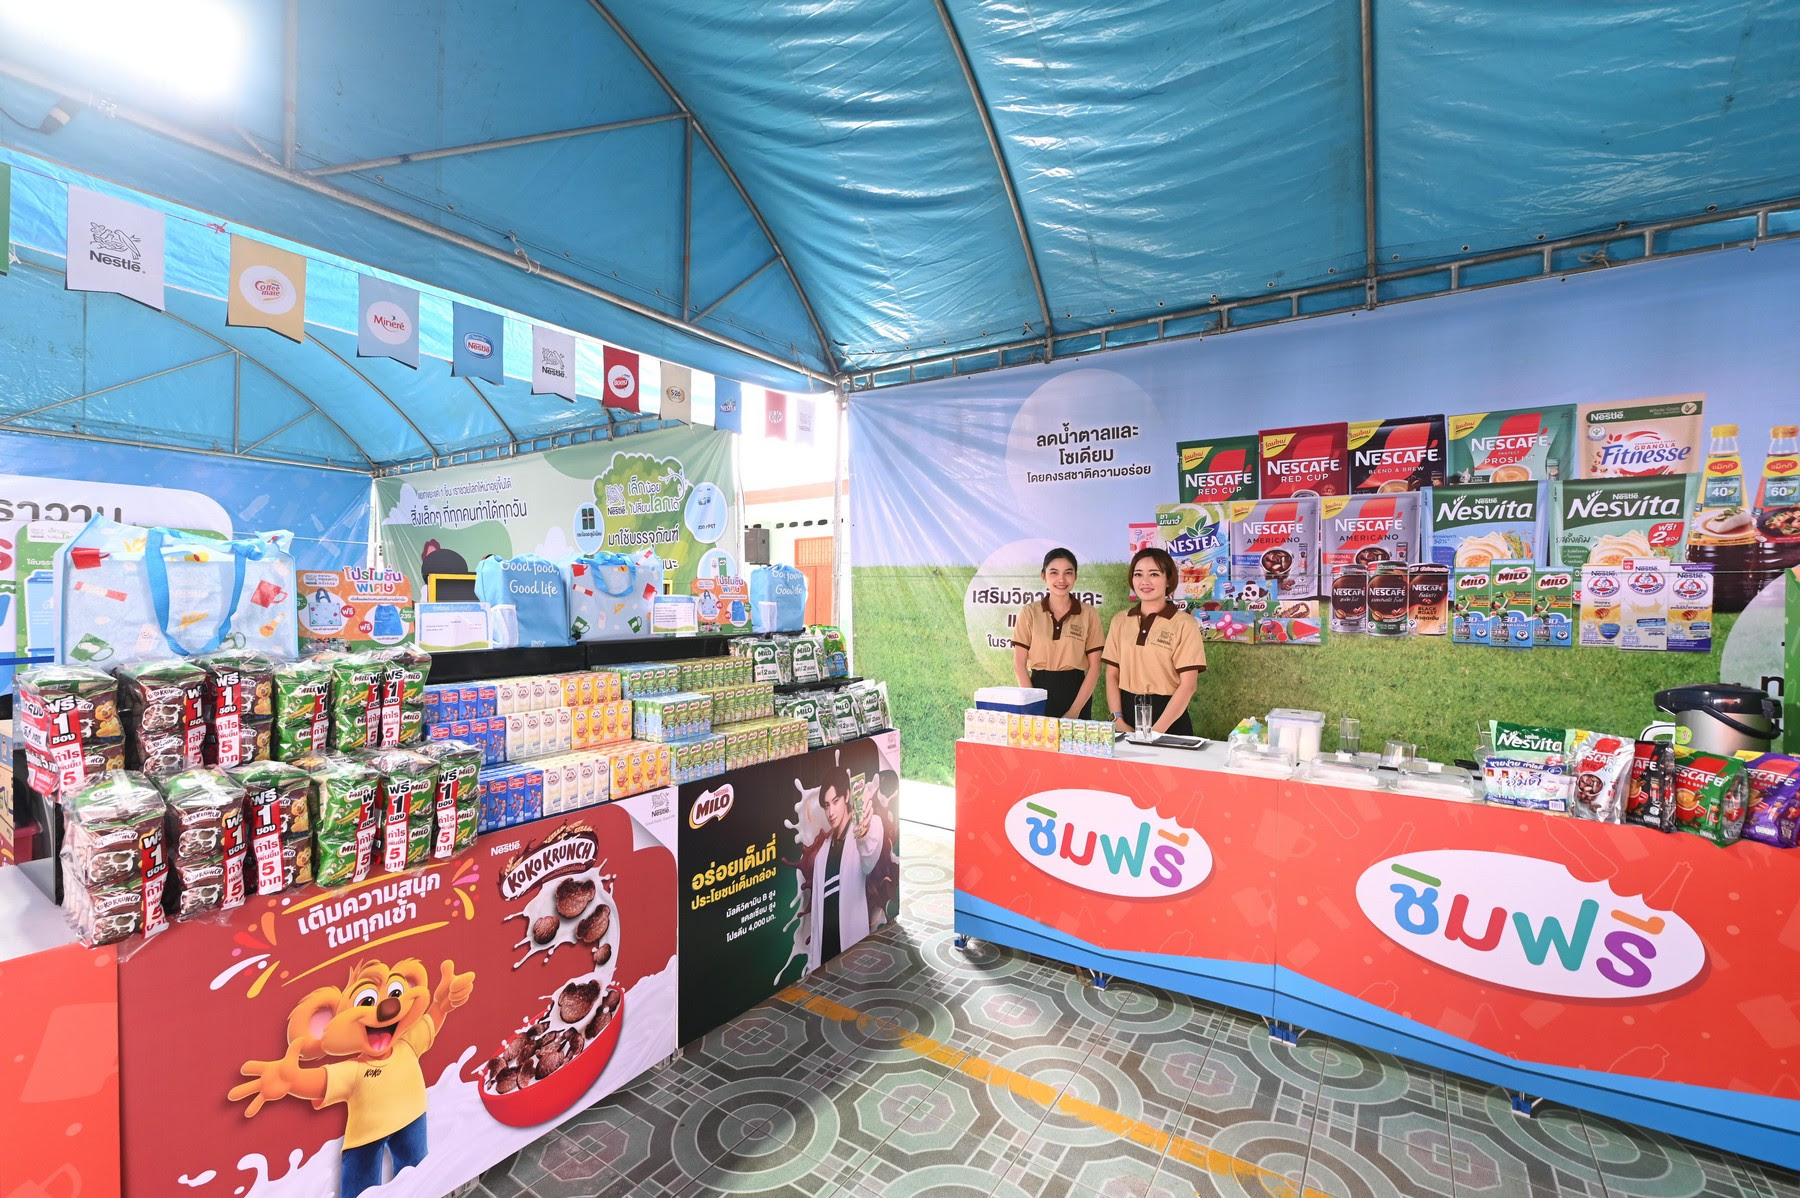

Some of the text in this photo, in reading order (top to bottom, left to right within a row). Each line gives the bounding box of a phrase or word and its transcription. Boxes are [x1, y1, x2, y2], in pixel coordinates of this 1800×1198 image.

[89, 250, 141, 272] Nestlé
[1590, 411, 1624, 421] Nestlé
[1036, 422, 1139, 448] ลดน้ำตาลและ
[1471, 428, 1549, 452] NESCAFÉ
[1355, 440, 1438, 467] NESCAFÉ
[1634, 442, 1676, 451] GRANOLA
[1058, 445, 1114, 465] โซเดียม
[1267, 450, 1340, 475] NESCAFÉ
[1484, 455, 1533, 465] PROSLIM
[1601, 444, 1692, 466] Fitnesse
[1027, 463, 1152, 483] โดยคงรสชาติความอร่อย
[1185, 465, 1253, 488] NESCAFÉ
[1281, 474, 1329, 483] RED CUP
[1198, 486, 1242, 495] RED CUP
[443, 498, 528, 528] ที่ทุกคนทำได้ทุกวัน
[1436, 497, 1533, 523] Nesvita
[1566, 494, 1680, 520] Nesvita
[1242, 516, 1304, 535] NESCAFÉ
[1335, 512, 1403, 532] NESCAFÉ
[1166, 536, 1220, 554] NESTEA
[1338, 534, 1399, 542] AMERICANO
[1650, 531, 1668, 544] 2
[1460, 579, 1487, 587] MILO
[1497, 572, 1529, 582] MILO
[1540, 578, 1568, 587] MILO
[509, 579, 558, 597] Good life
[1369, 587, 1406, 597] NESCAFÉ
[796, 646, 811, 654] MILO
[216, 672, 240, 688] ฟรี
[385, 669, 405, 681] ฟรี
[222, 686, 234, 706] 1
[389, 682, 399, 698] 1
[46, 695, 77, 713] ฟรี
[796, 706, 813, 715] MILO
[52, 712, 71, 735] 1
[385, 727, 394, 739] 5
[221, 741, 234, 753] 5
[1497, 732, 1563, 752] Nesvita
[63, 771, 77, 786] 5
[438, 769, 458, 783] ฟรี
[458, 767, 475, 776] MILO
[1676, 767, 1724, 787] ESCAFÉ
[389, 781, 410, 794] ฟรี
[410, 783, 429, 791] MILO
[441, 783, 451, 800] 1
[1692, 782, 1709, 790] BREW
[250, 788, 278, 806] ฟรี
[393, 795, 404, 813] 1
[257, 804, 272, 825] 1
[695, 793, 730, 820] MILO
[457, 811, 474, 820] MILO
[232, 826, 244, 845] 1
[388, 829, 406, 838] กำไร
[410, 829, 429, 838] MILO
[440, 831, 450, 843] 5
[255, 840, 279, 853] กำไร
[490, 841, 521, 857] Nestlé
[1025, 801, 1190, 888] ชิมฟรี
[150, 847, 163, 867] 1
[389, 848, 401, 860] 5
[691, 833, 777, 891] อร่อยเต็มที่
[261, 862, 275, 877] 5
[507, 858, 542, 894] KOKO
[542, 841, 593, 871] KRUNCH
[231, 882, 243, 896] 5
[259, 875, 282, 888] บาท
[690, 867, 777, 911] ประโยชน์เต็มกล่อง
[298, 873, 441, 935] เติมความสนุก
[762, 893, 768, 901] B
[151, 907, 163, 920] 5
[325, 900, 417, 949] ในทุกเช้า
[1389, 863, 1667, 989] ชิมฟรี
